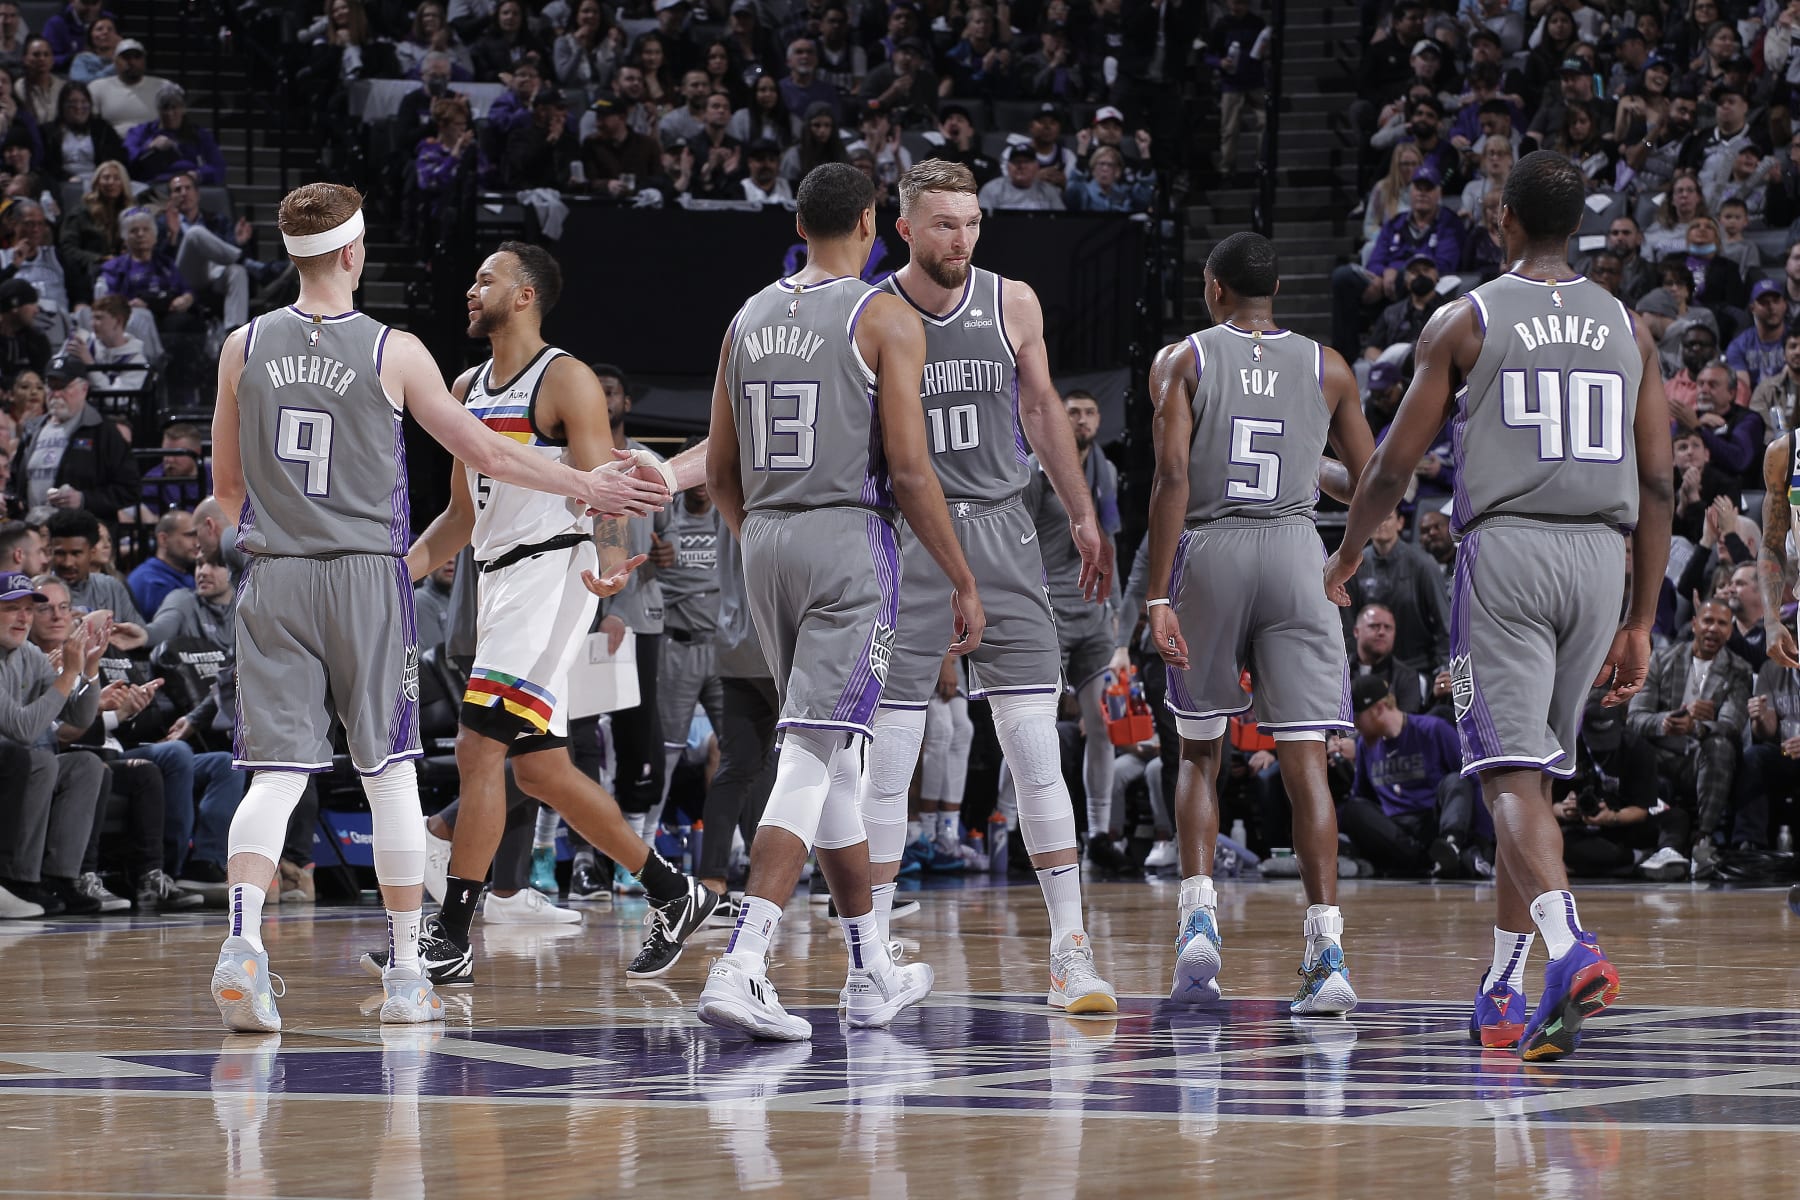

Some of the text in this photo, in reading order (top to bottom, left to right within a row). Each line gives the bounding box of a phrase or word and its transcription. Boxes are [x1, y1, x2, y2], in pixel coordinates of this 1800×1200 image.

[963, 319, 993, 329] dialpad
[1514, 314, 1610, 351] BARNES
[743, 325, 825, 364] MURRAY
[265, 355, 357, 397] HUERTER
[920, 360, 1003, 398] RAMENTO
[1239, 368, 1280, 398] FOX
[742, 381, 821, 472] 13
[927, 403, 980, 454] 10
[1500, 368, 1625, 464] 40
[274, 405, 335, 499] 9
[1224, 415, 1285, 503] 5
[178, 650, 226, 664] MATTRESS
